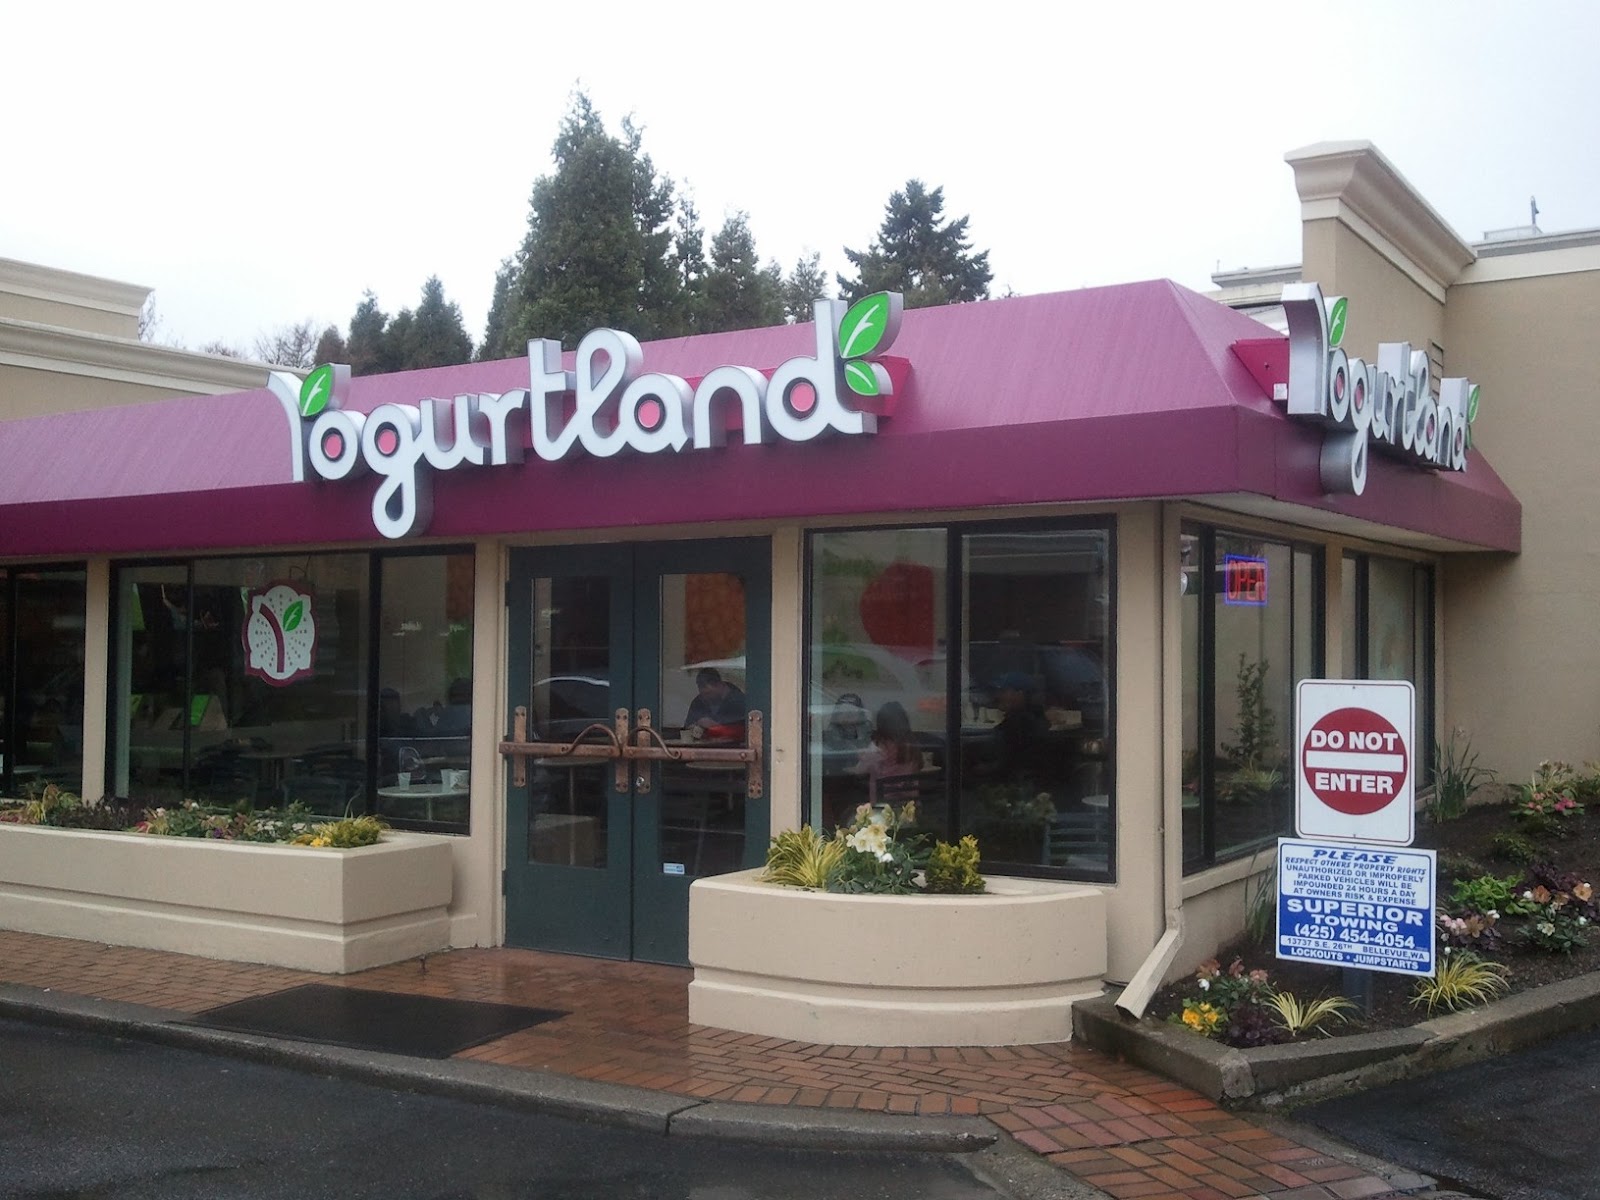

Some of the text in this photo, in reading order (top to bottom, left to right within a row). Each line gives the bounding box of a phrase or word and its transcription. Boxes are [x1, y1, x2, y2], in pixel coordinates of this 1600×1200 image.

[267, 299, 877, 539] Yogurtland
[1228, 560, 1266, 601] OPEN
[1311, 730, 1398, 751] DO NOT
[1315, 772, 1393, 794] ENTER
[1313, 849, 1398, 864] PLEASE
[1287, 865, 1352, 876] UNAUTHORIZED
[1370, 872, 1424, 883] IMPROPERLY
[1321, 860, 1351, 868] OTHERS
[1353, 863, 1394, 871] PROPERTY
[1398, 867, 1426, 875] RIGHTS
[1294, 881, 1344, 890] IMPOUNDED
[1359, 886, 1388, 894] HOURS
[1298, 873, 1331, 882] PARKED
[1334, 876, 1375, 886] VEHICLES
[1307, 889, 1342, 898] OWNERS
[1377, 896, 1416, 905] EXPENSE
[1287, 899, 1423, 926] SUPERIOR
[1311, 914, 1398, 932] TOWING
[1287, 938, 1312, 946] 13737
[1295, 923, 1415, 949] (425) 454-4054
[1291, 948, 1418, 970] LOCKOUTS JUMPSTARTS
